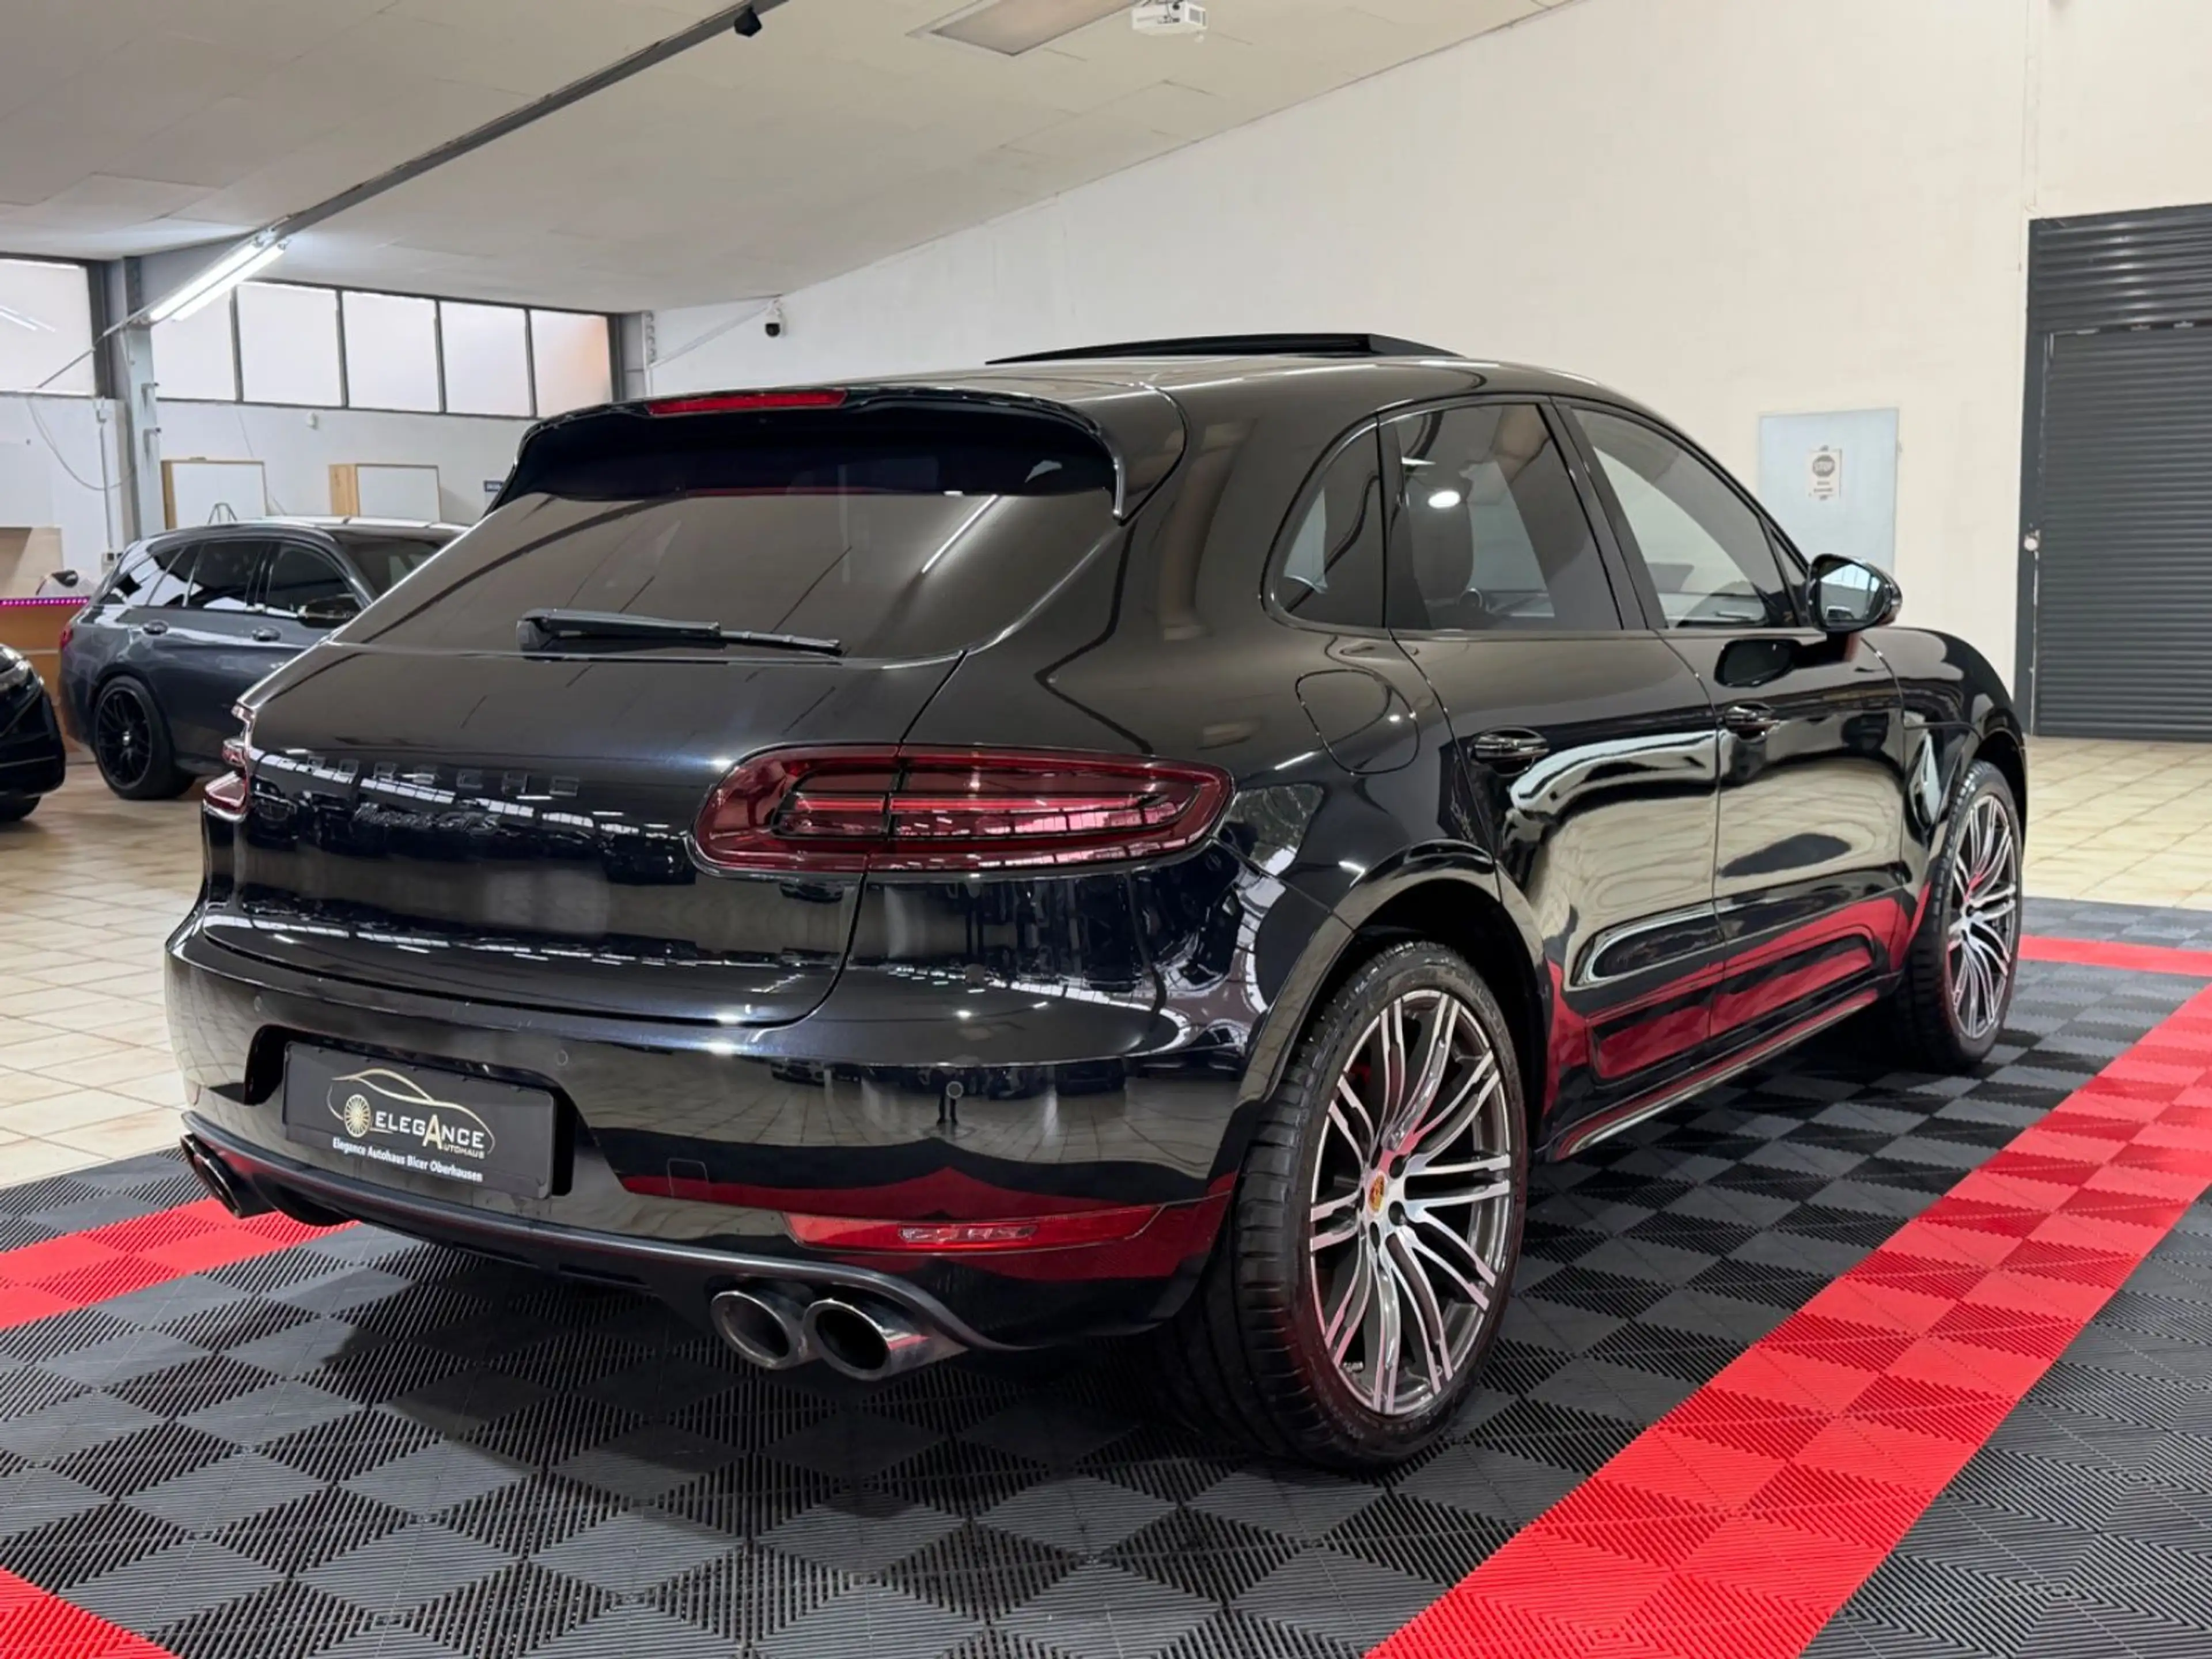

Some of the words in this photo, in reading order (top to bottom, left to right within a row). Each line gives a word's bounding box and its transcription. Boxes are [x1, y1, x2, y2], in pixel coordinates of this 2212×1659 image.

[307, 756, 579, 796] PORSCHE
[375, 1111, 485, 1150] ELEGANCE
[332, 1137, 366, 1155] Elegance
[367, 1145, 406, 1165] Autohaus
[429, 1161, 483, 1183] Oberhausen
